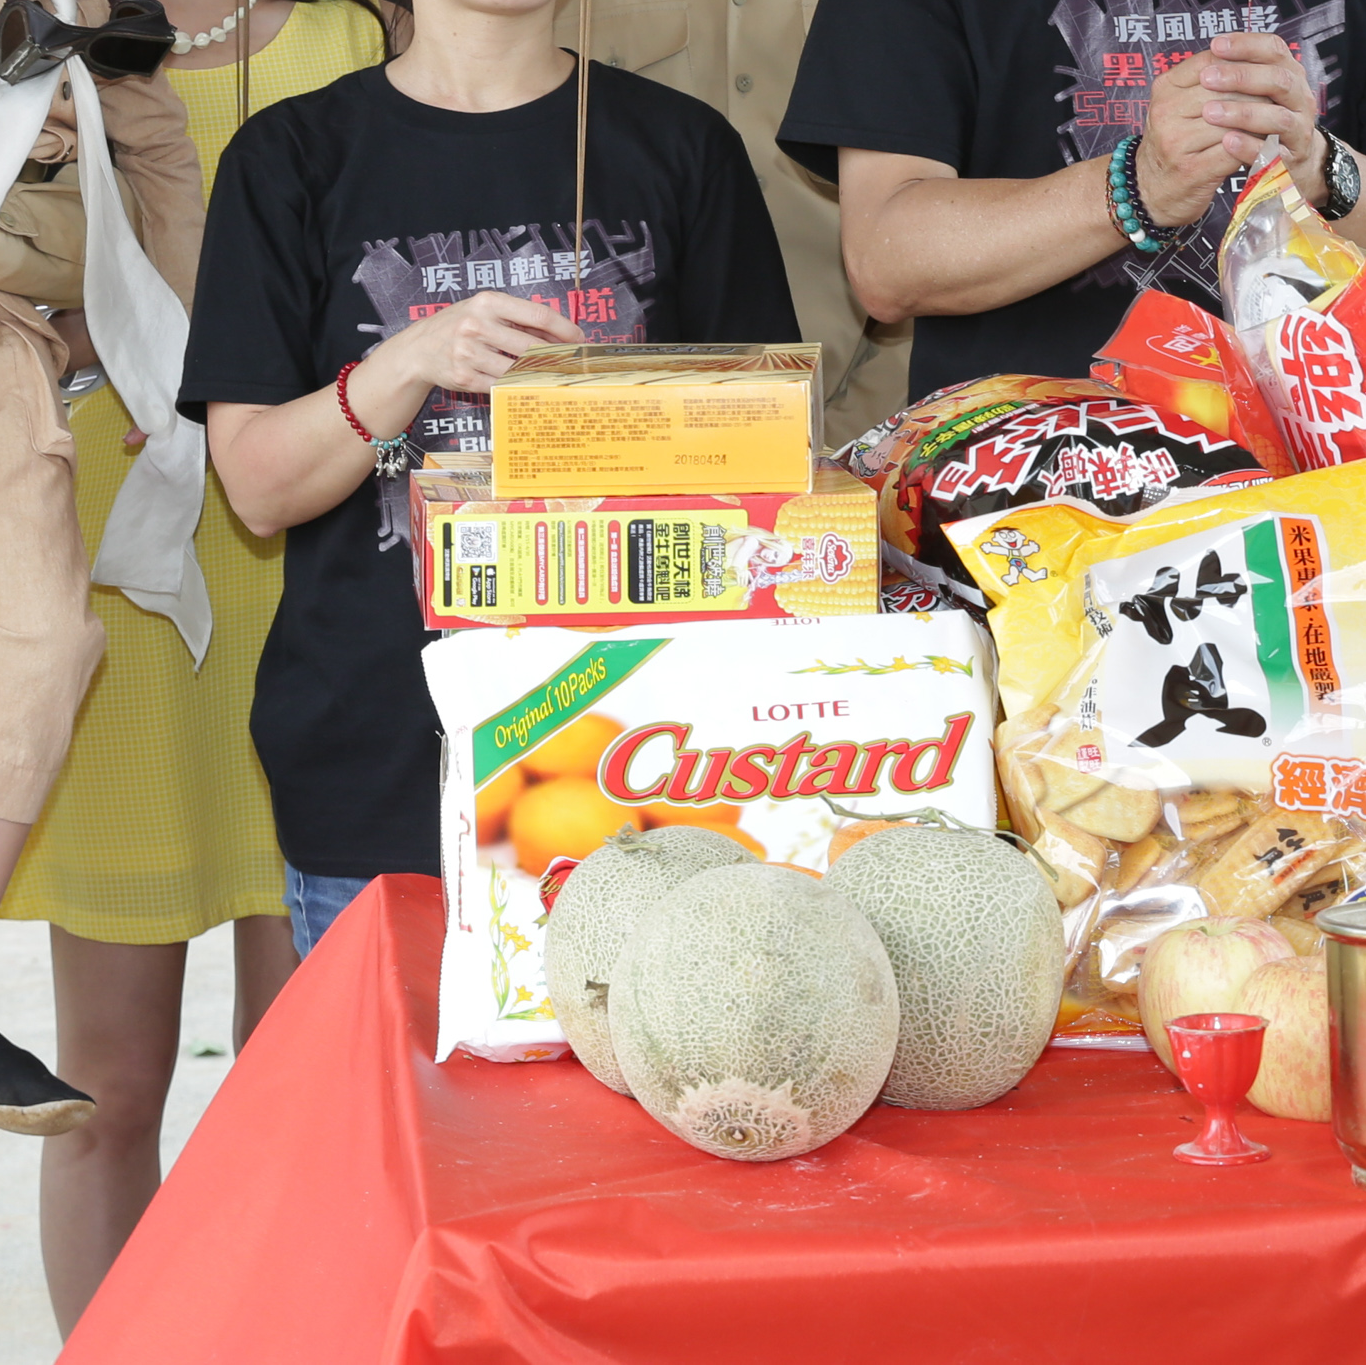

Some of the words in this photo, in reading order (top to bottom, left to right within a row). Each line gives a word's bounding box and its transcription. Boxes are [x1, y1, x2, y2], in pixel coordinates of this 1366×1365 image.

[1113, 5, 1281, 43] 疾風魅影
[421, 250, 593, 293] 疾風魅影
[422, 416, 483, 436] 35th
[674, 454, 727, 466] 20180424
[672, 522, 691, 599] 創世天梯
[801, 536, 816, 581] 喜年來
[770, 617, 821, 627] LOTTE
[494, 685, 554, 749] Original
[751, 700, 850, 722] LOTTE
[601, 711, 975, 805] Custard
